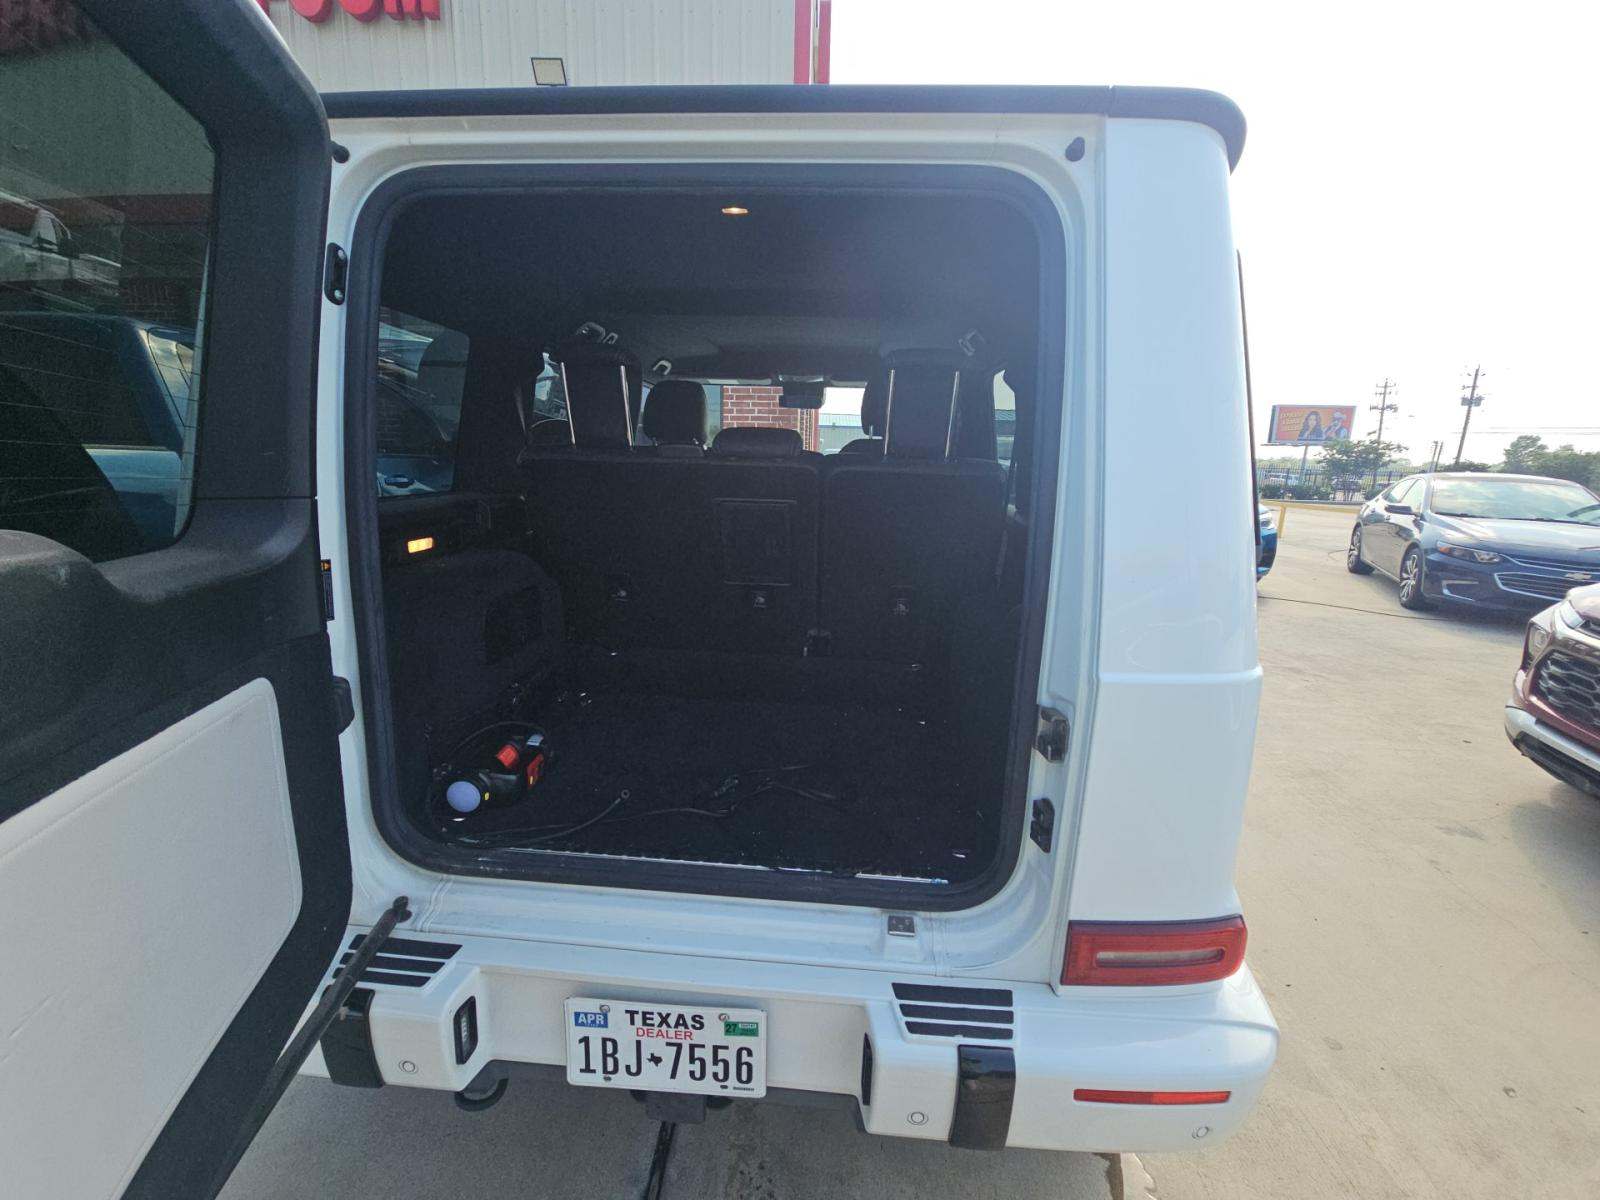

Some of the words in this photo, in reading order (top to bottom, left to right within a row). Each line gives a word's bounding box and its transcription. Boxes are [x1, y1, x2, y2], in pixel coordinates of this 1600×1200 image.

[577, 1013, 605, 1025] APR
[625, 1009, 705, 1030] TEXAS
[636, 1027, 694, 1041] DEALER
[726, 1023, 737, 1033] 27
